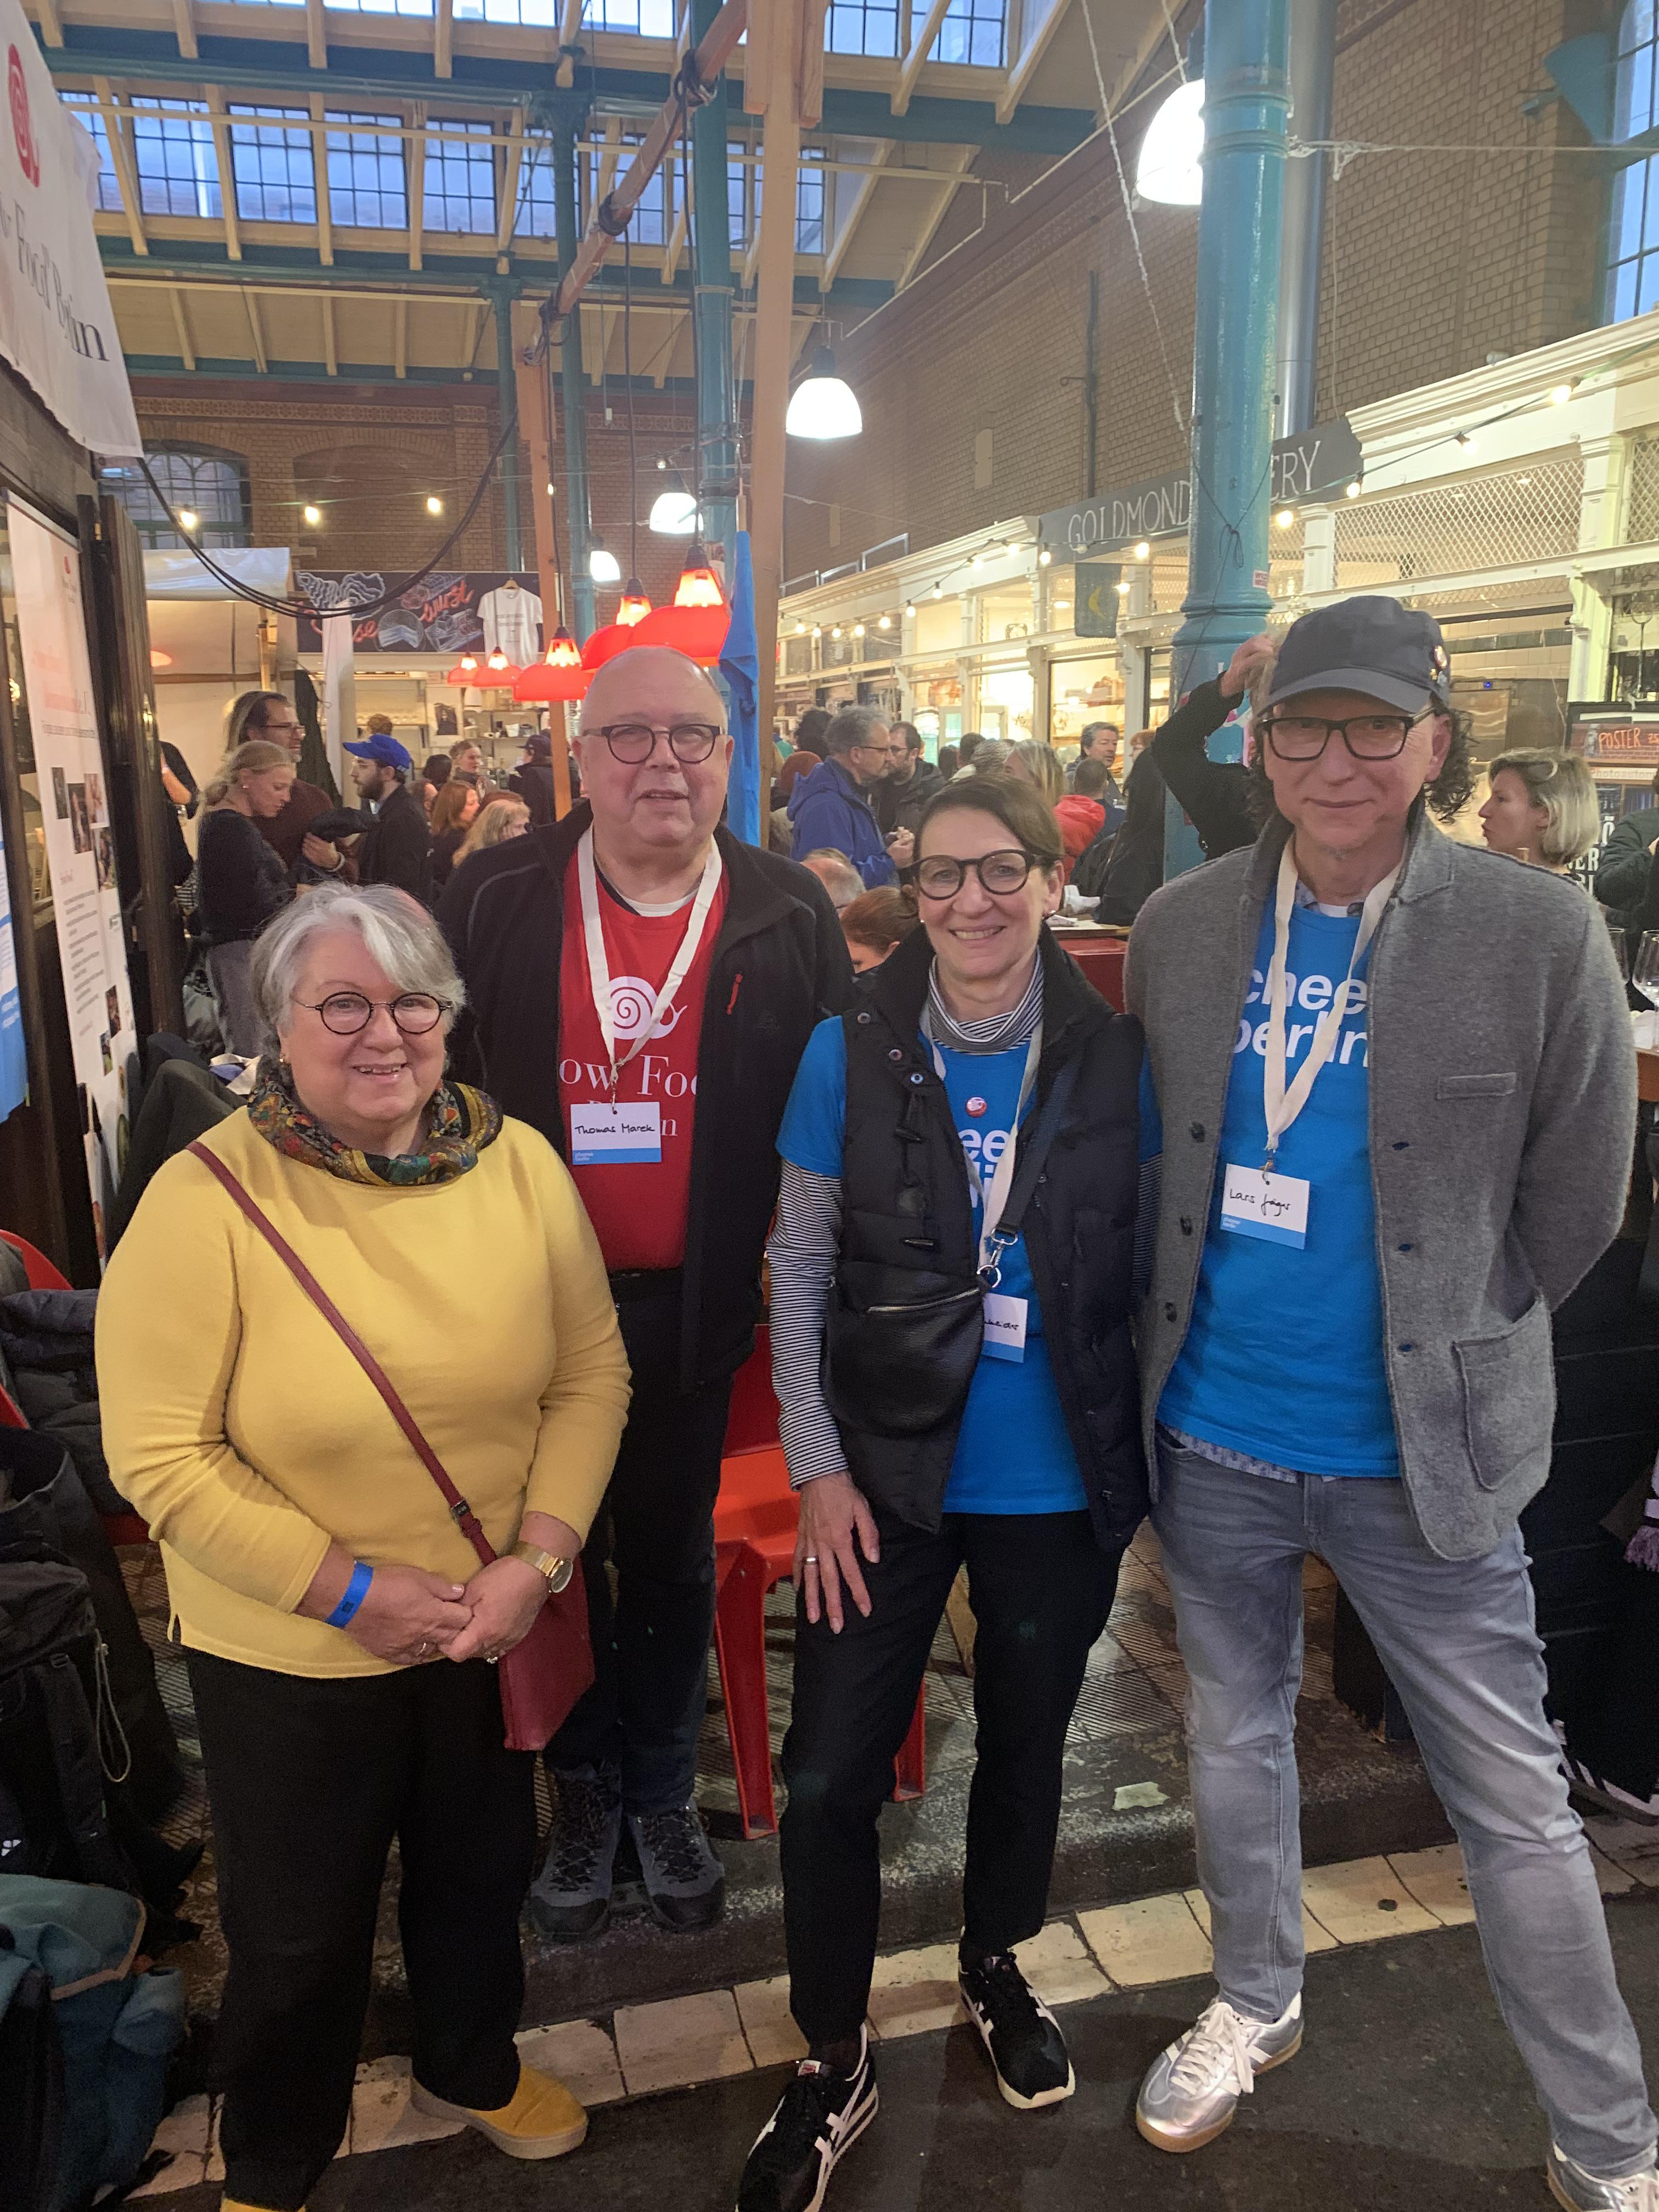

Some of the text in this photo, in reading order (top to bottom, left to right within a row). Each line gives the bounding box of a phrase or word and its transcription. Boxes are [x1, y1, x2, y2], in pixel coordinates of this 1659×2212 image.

[1598, 727, 1641, 753] POSTER
[574, 1125, 616, 1133] Thomas
[1229, 1188, 1255, 1204] Lars
